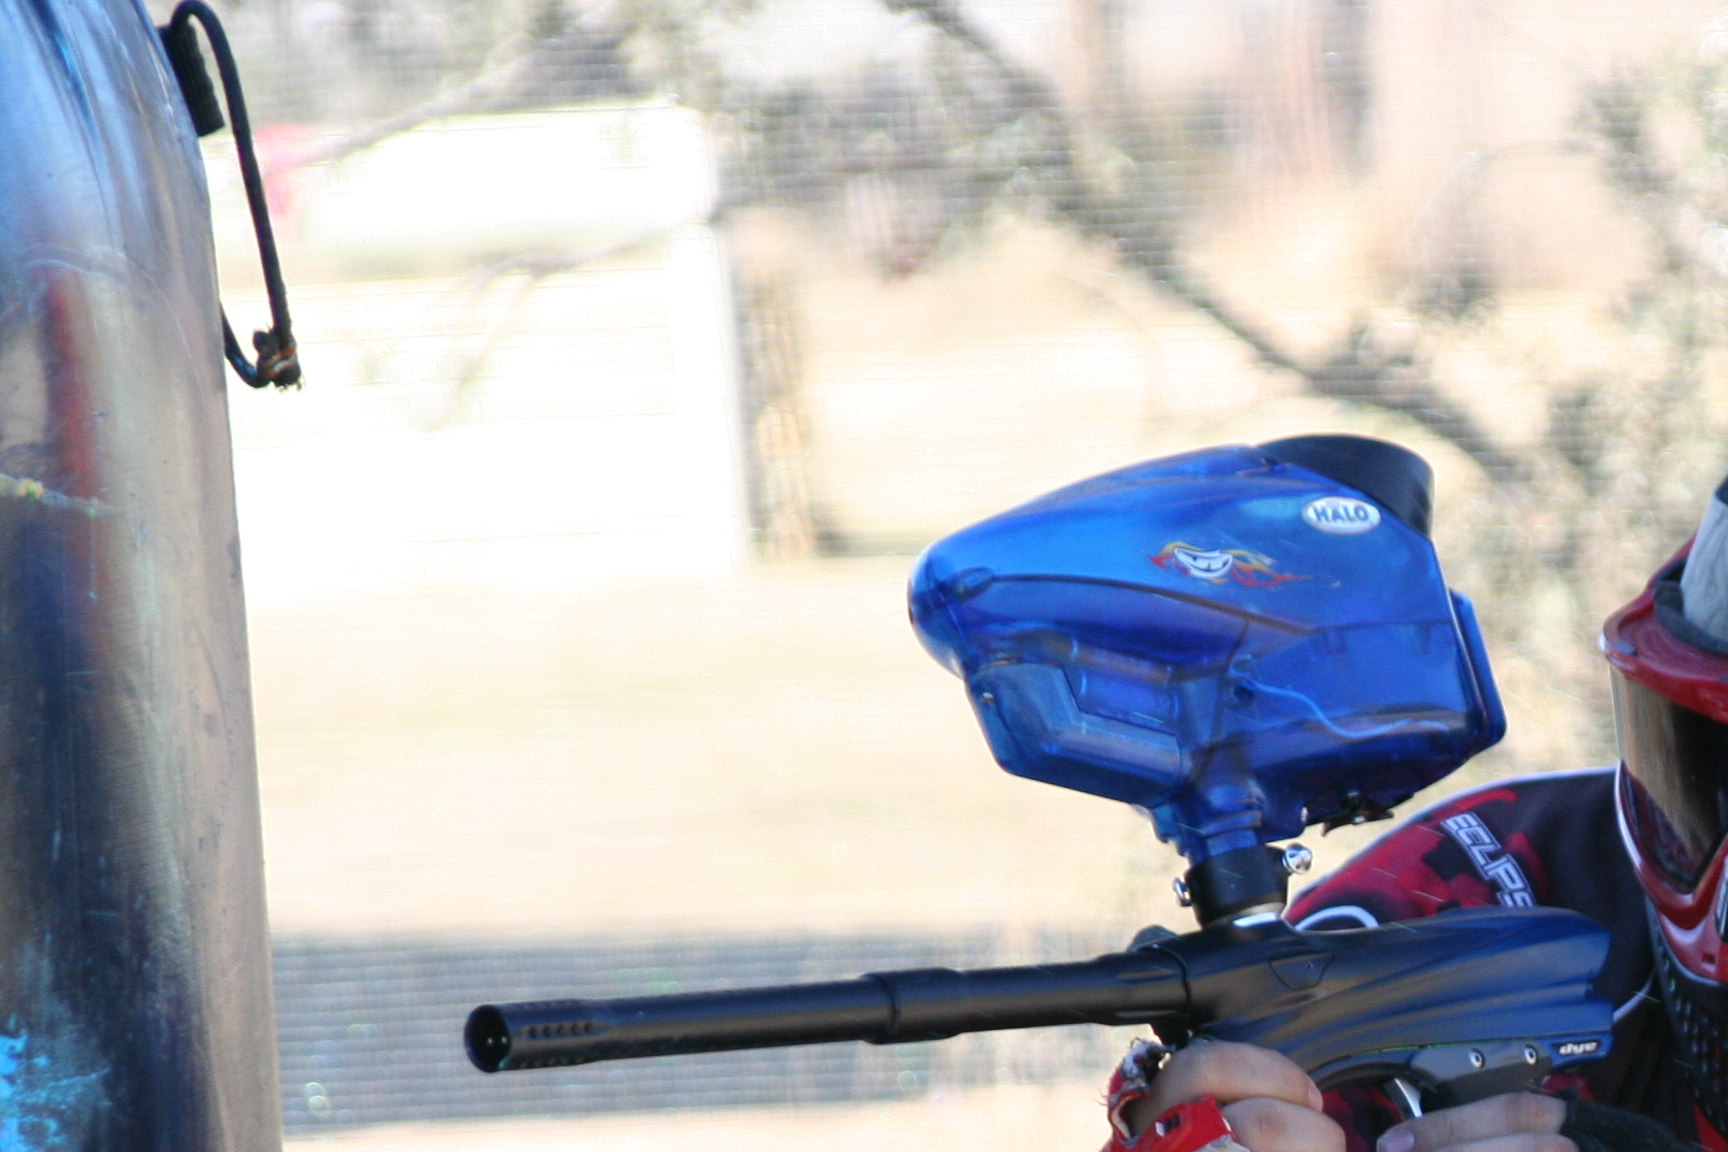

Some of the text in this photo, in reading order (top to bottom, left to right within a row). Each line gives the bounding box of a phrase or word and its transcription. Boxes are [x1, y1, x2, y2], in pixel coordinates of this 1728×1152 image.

[1312, 503, 1369, 523] HALO
[1440, 811, 1538, 907] ECLIPS
[1558, 1040, 1599, 1056] dye
